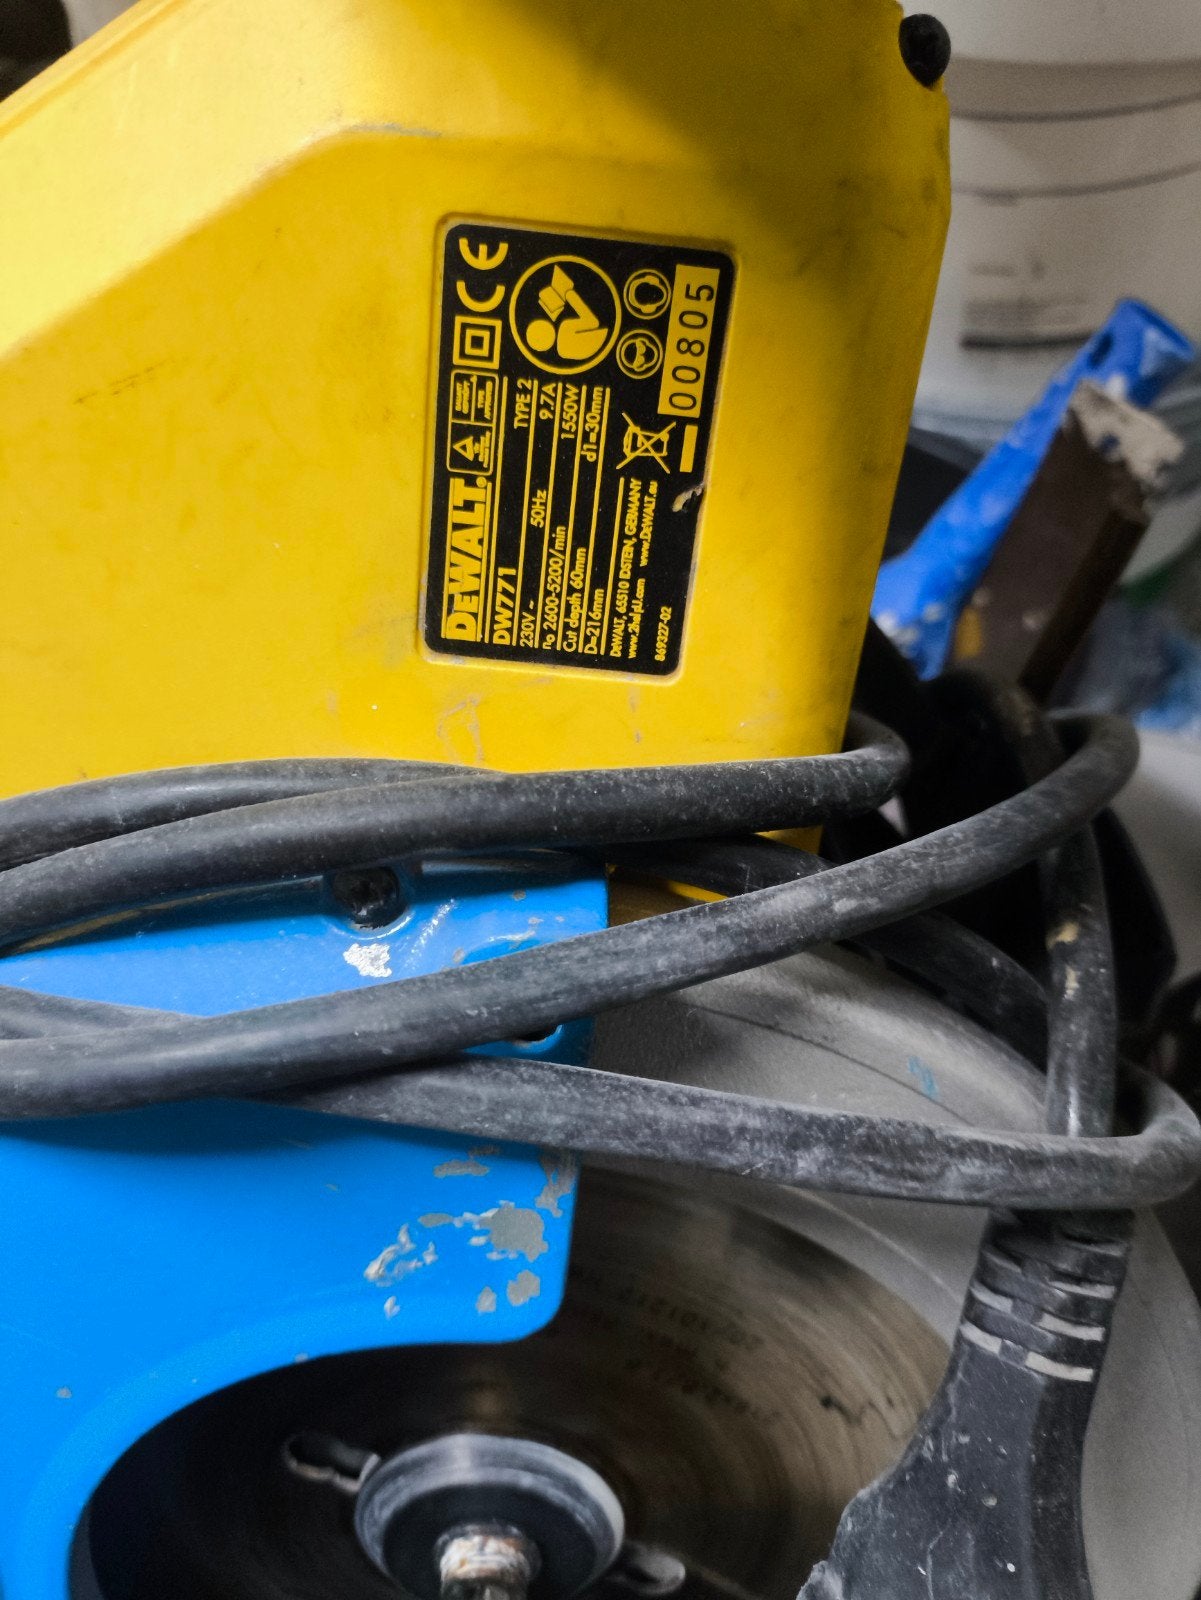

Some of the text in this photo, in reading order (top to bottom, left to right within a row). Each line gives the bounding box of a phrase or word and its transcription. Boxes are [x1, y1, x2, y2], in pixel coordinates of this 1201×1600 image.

[669, 284, 714, 410] 00805
[493, 378, 532, 645] DW771 TYPE 2
[520, 612, 535, 647] 230V
[530, 490, 547, 528] 50Hz
[539, 383, 556, 419] 9.7A
[543, 526, 566, 631] 2600-5200/min
[561, 384, 579, 439] 1550W
[563, 387, 603, 652] Cut depth 60mm d1=30mm
[616, 581, 629, 613] 65510
[625, 478, 641, 535] GERMANY
[584, 589, 604, 654] D=216mm
[655, 606, 671, 661] 869327-02
